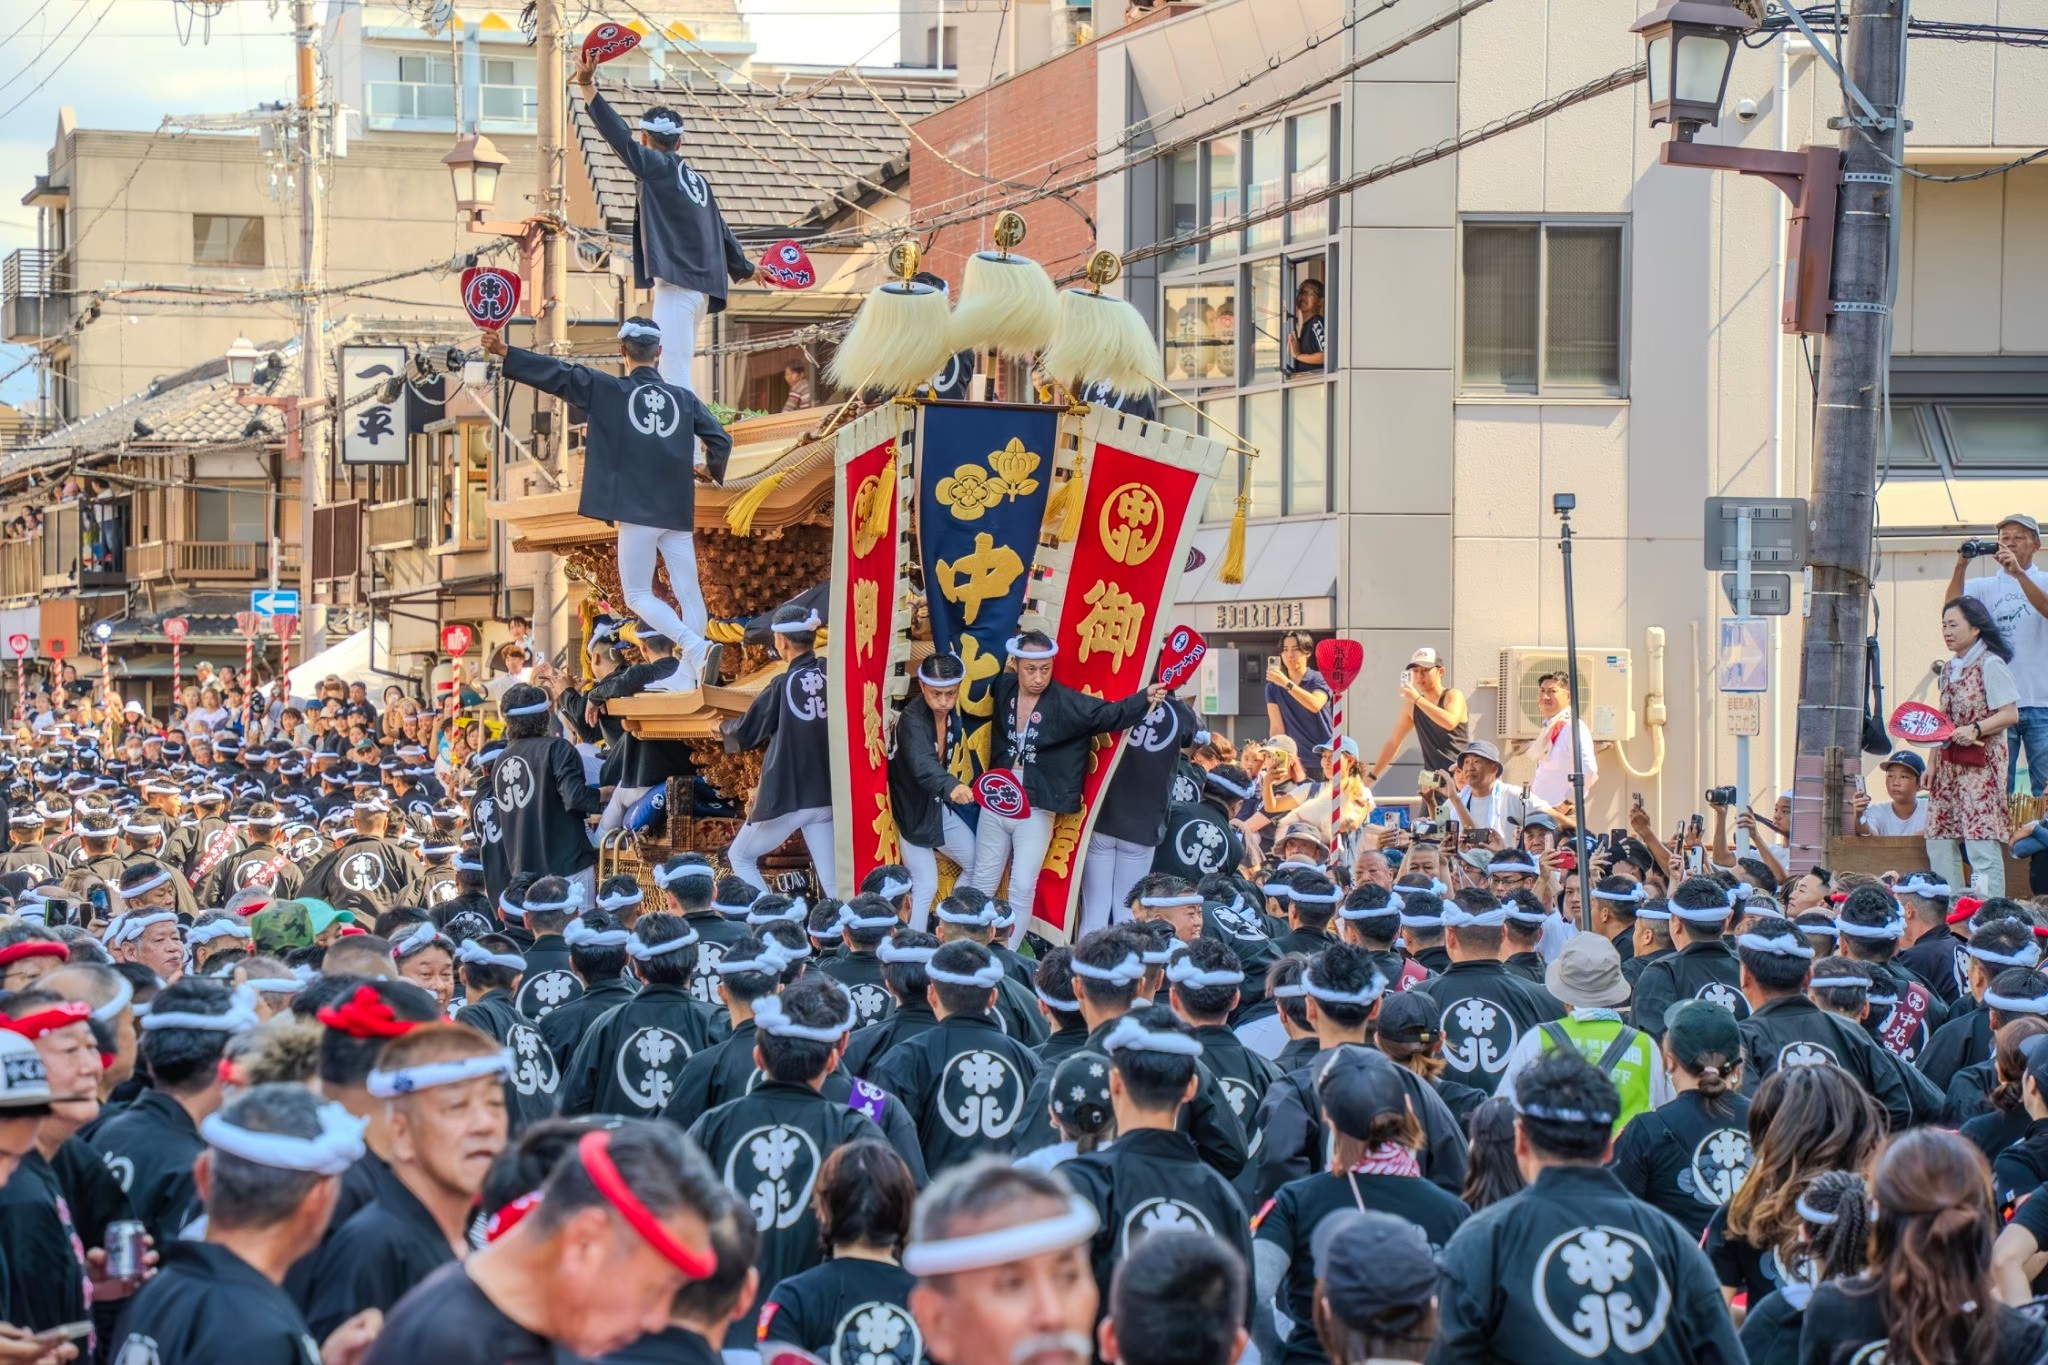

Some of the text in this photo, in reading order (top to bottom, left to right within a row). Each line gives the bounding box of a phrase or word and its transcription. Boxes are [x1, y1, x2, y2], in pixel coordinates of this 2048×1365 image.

[355, 363, 395, 446] 一平
[1098, 481, 1165, 566] 中北
[1216, 602, 1304, 629] 岸和田北町郵便局
[1728, 714, 1758, 732] ここから
[1440, 996, 1518, 1074] 中北
[938, 1049, 1025, 1139] 中北
[1532, 1224, 1672, 1359] 中北
